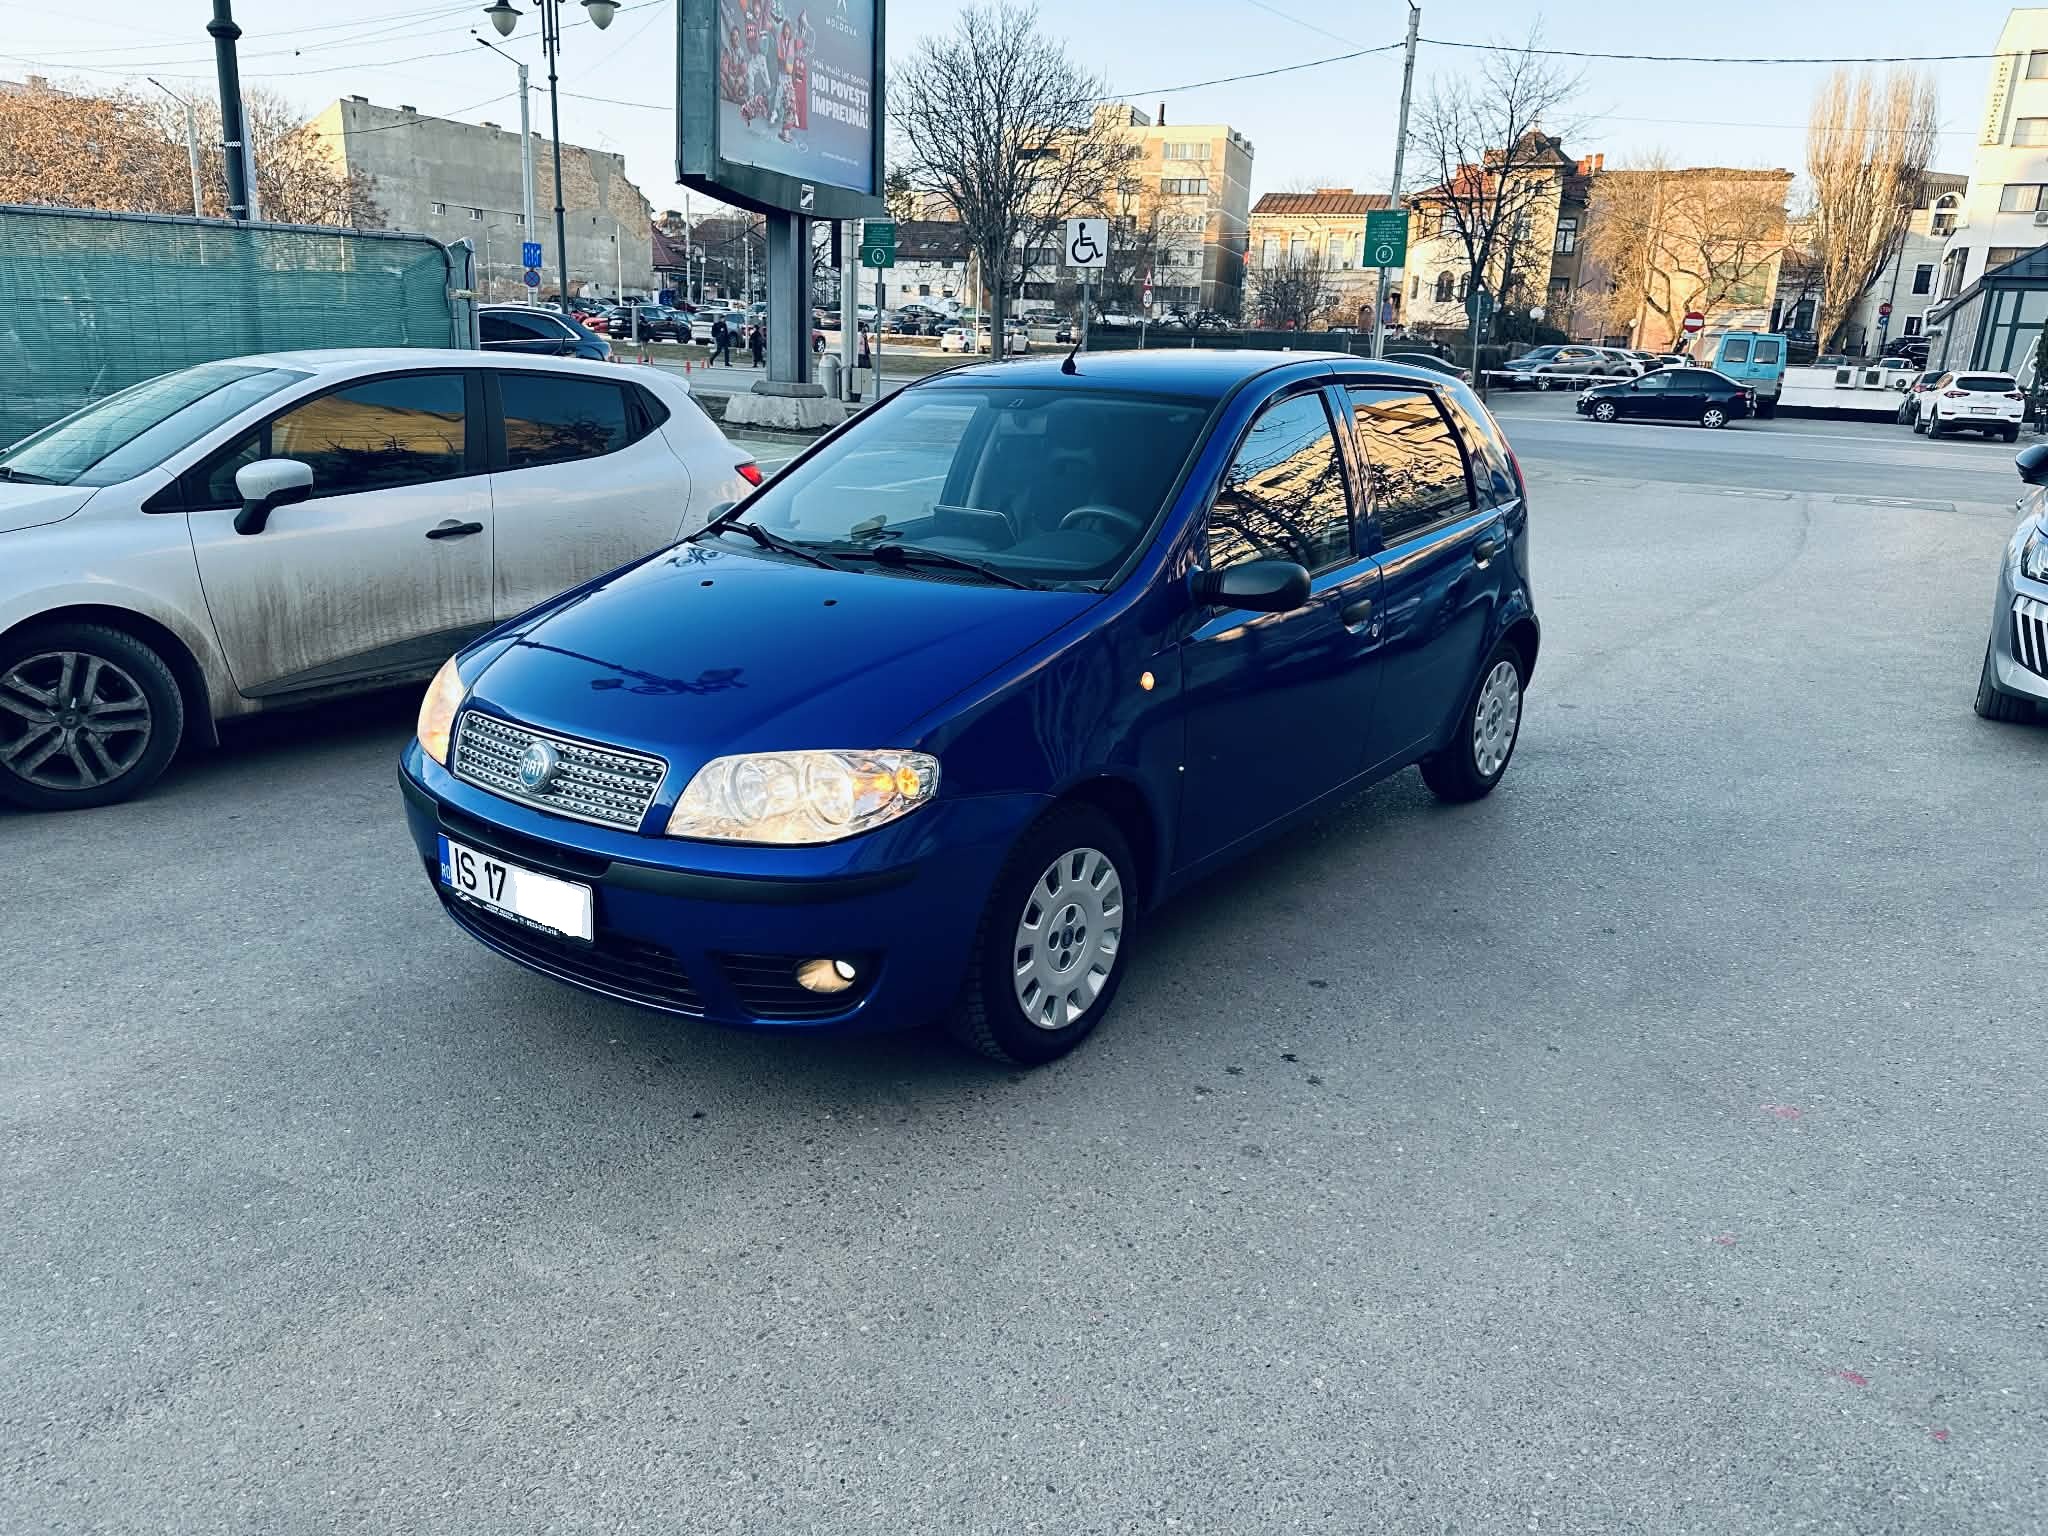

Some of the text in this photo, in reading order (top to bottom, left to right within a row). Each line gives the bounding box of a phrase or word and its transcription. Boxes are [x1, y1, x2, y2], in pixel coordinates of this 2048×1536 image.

[812, 71, 868, 108] NOI POVEȘTI
[441, 862, 451, 880] RO
[455, 847, 477, 891] IS
[484, 861, 506, 902] 17
